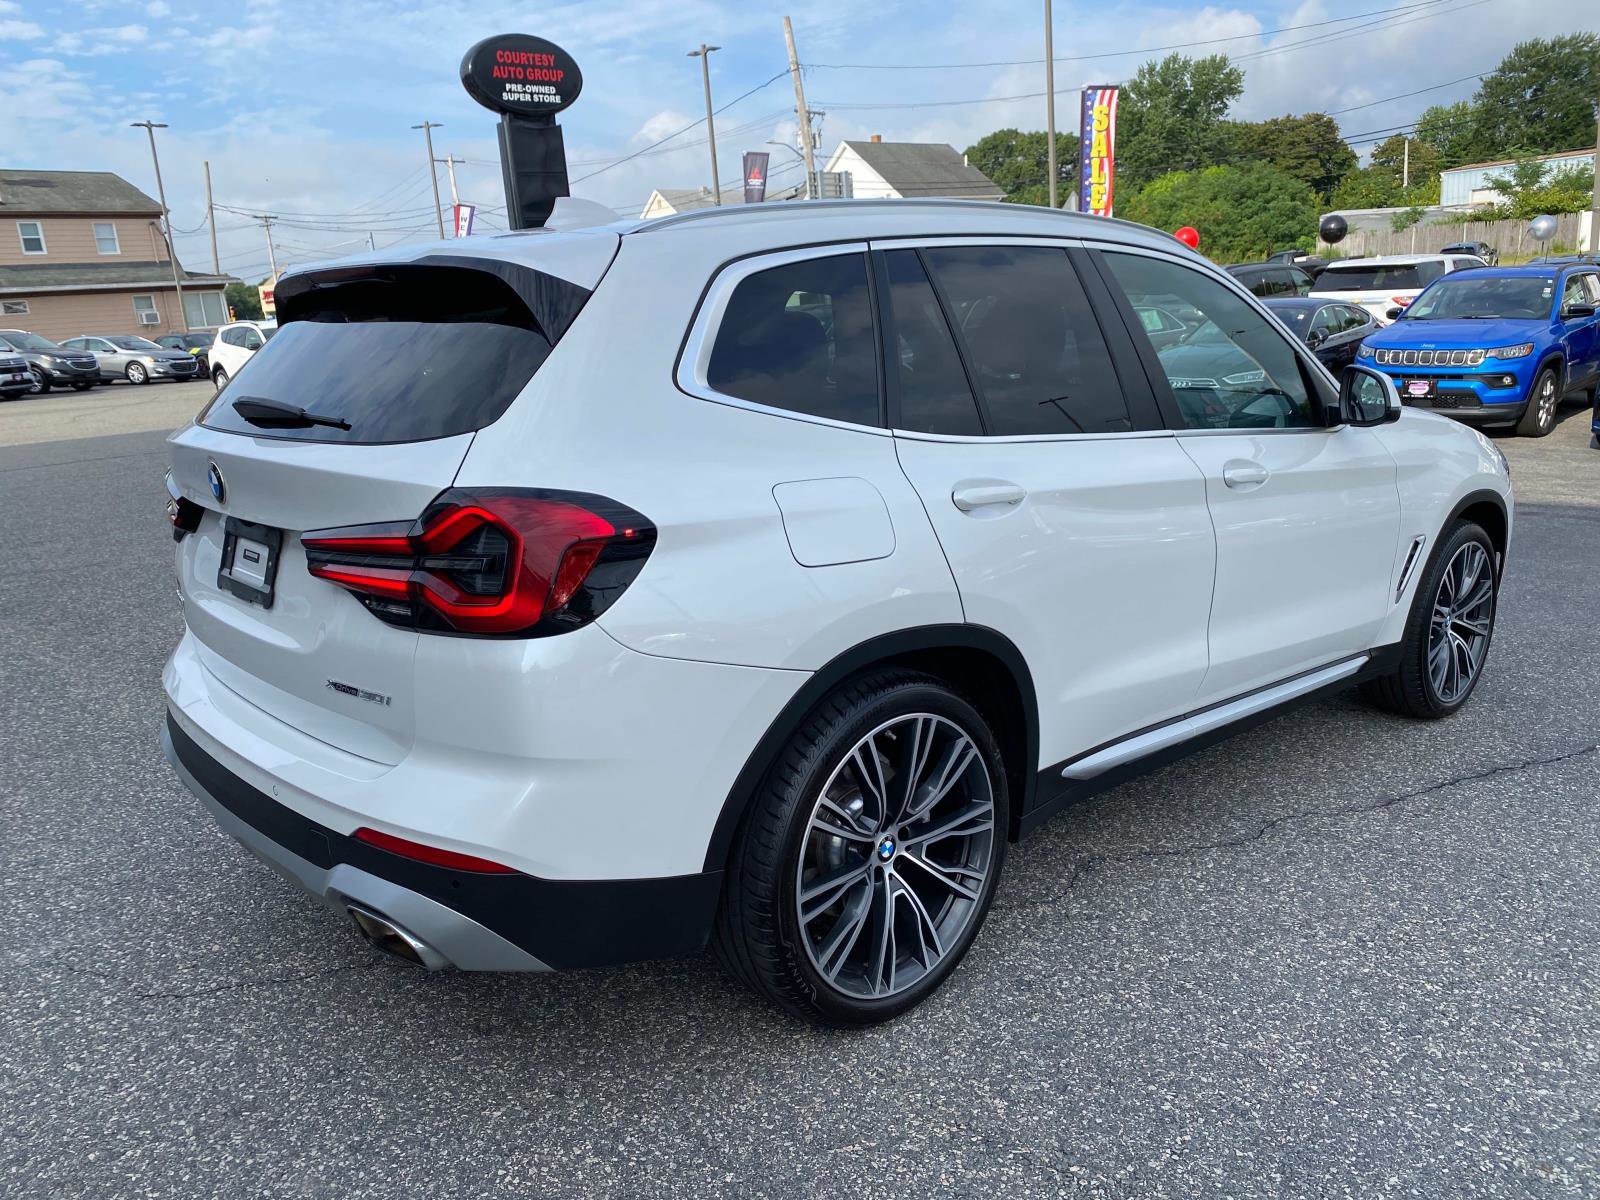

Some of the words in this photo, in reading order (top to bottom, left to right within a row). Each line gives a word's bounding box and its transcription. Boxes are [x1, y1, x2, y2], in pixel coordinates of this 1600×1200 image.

[496, 50, 555, 67] COURTESY
[492, 65, 524, 80] AUTO
[526, 68, 564, 82] GROUP
[505, 83, 556, 94] PRE-OWNED
[502, 92, 532, 102] SUPER
[533, 94, 562, 103] STORE
[1090, 105, 1109, 210] SALE
